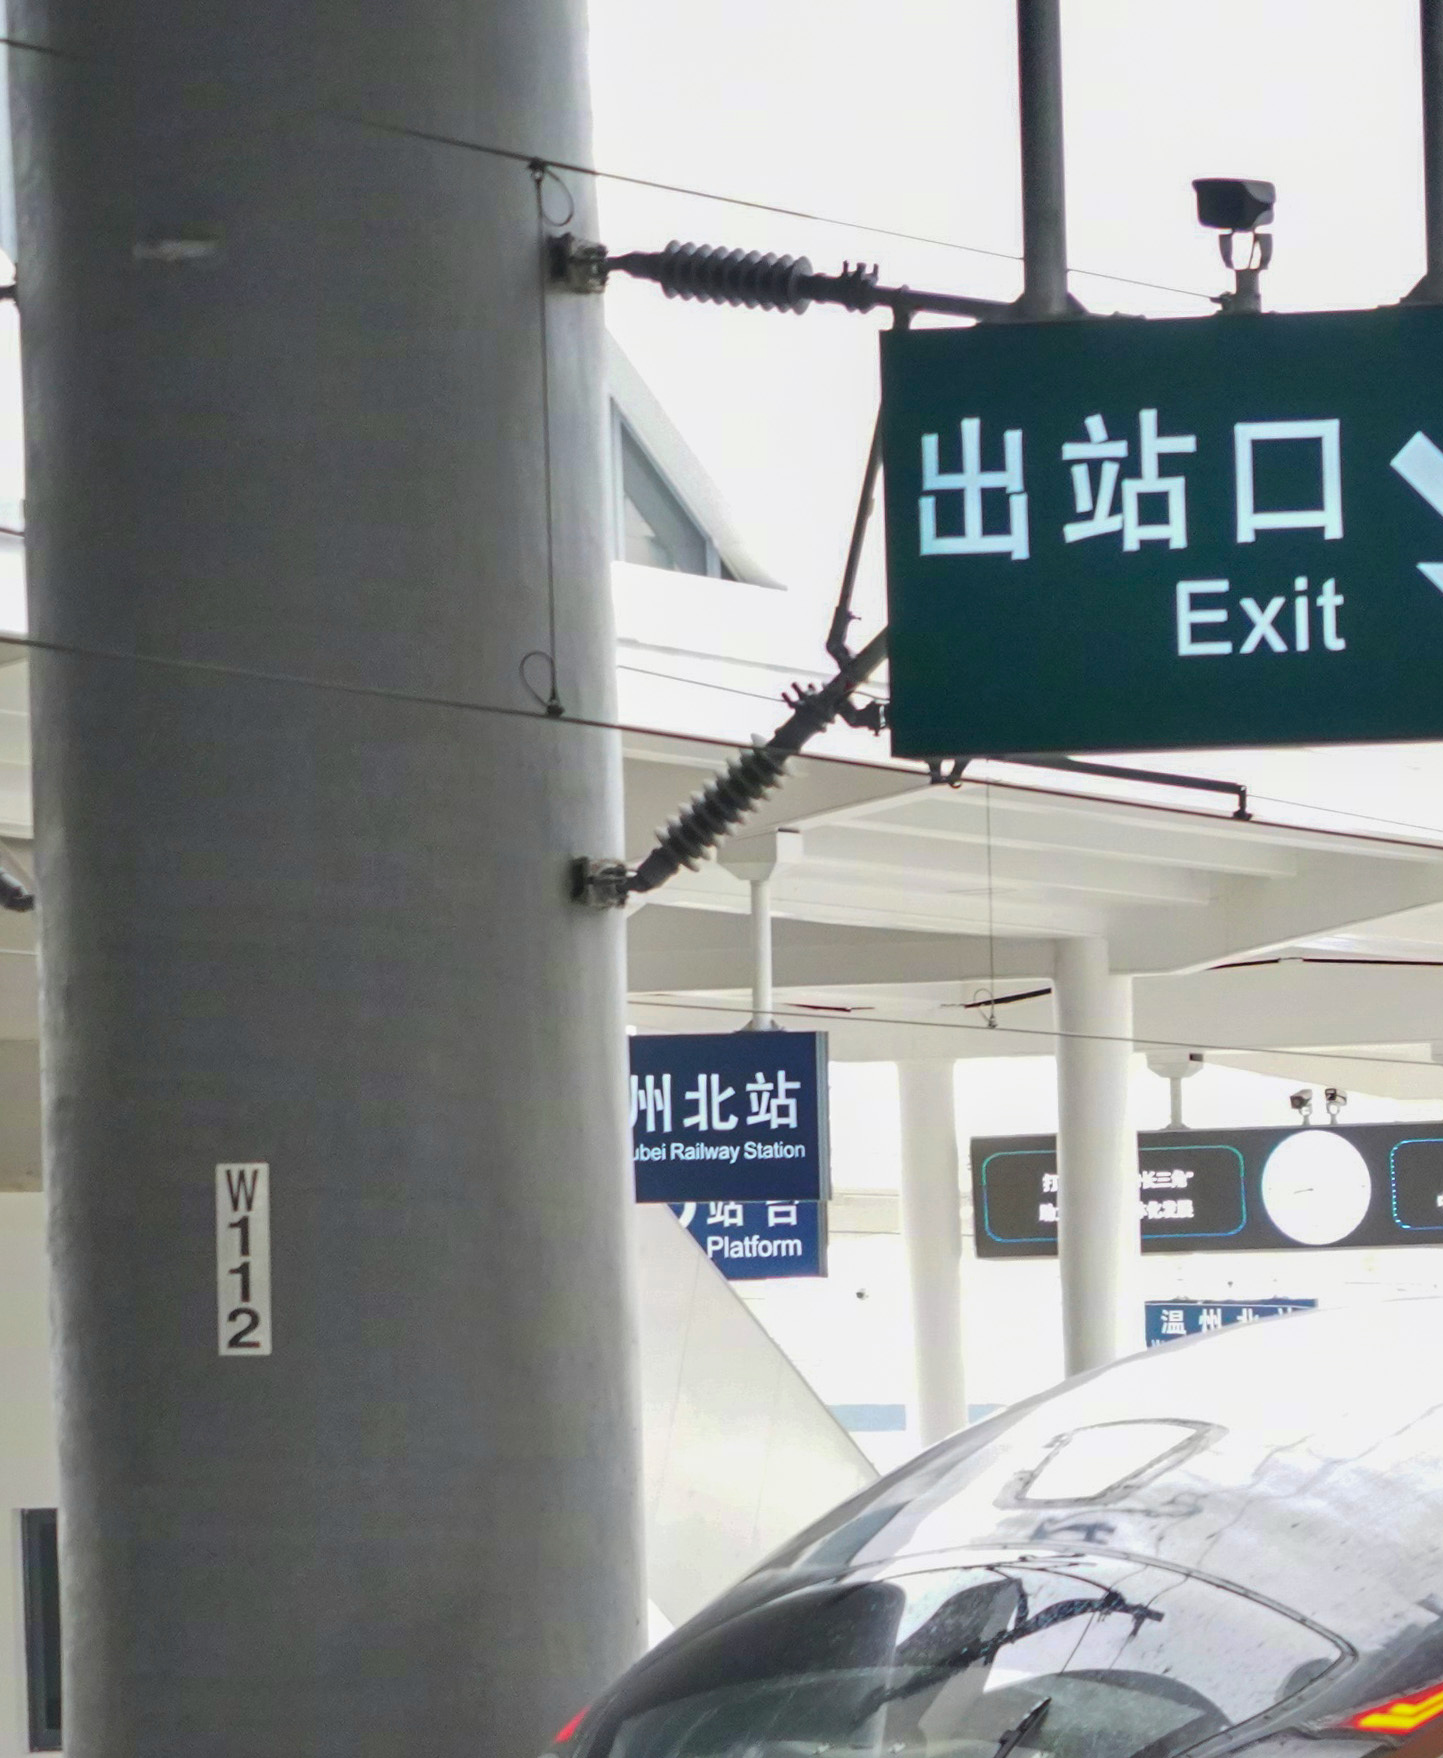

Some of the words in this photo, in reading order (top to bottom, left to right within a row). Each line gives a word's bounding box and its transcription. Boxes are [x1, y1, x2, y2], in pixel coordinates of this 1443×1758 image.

[919, 408, 1344, 561] 出站口
[1176, 576, 1346, 656] Exit
[669, 1142, 741, 1164] Railway
[743, 1140, 806, 1160] Station
[225, 1169, 262, 1350] W112
[706, 1234, 803, 1260] Platform
